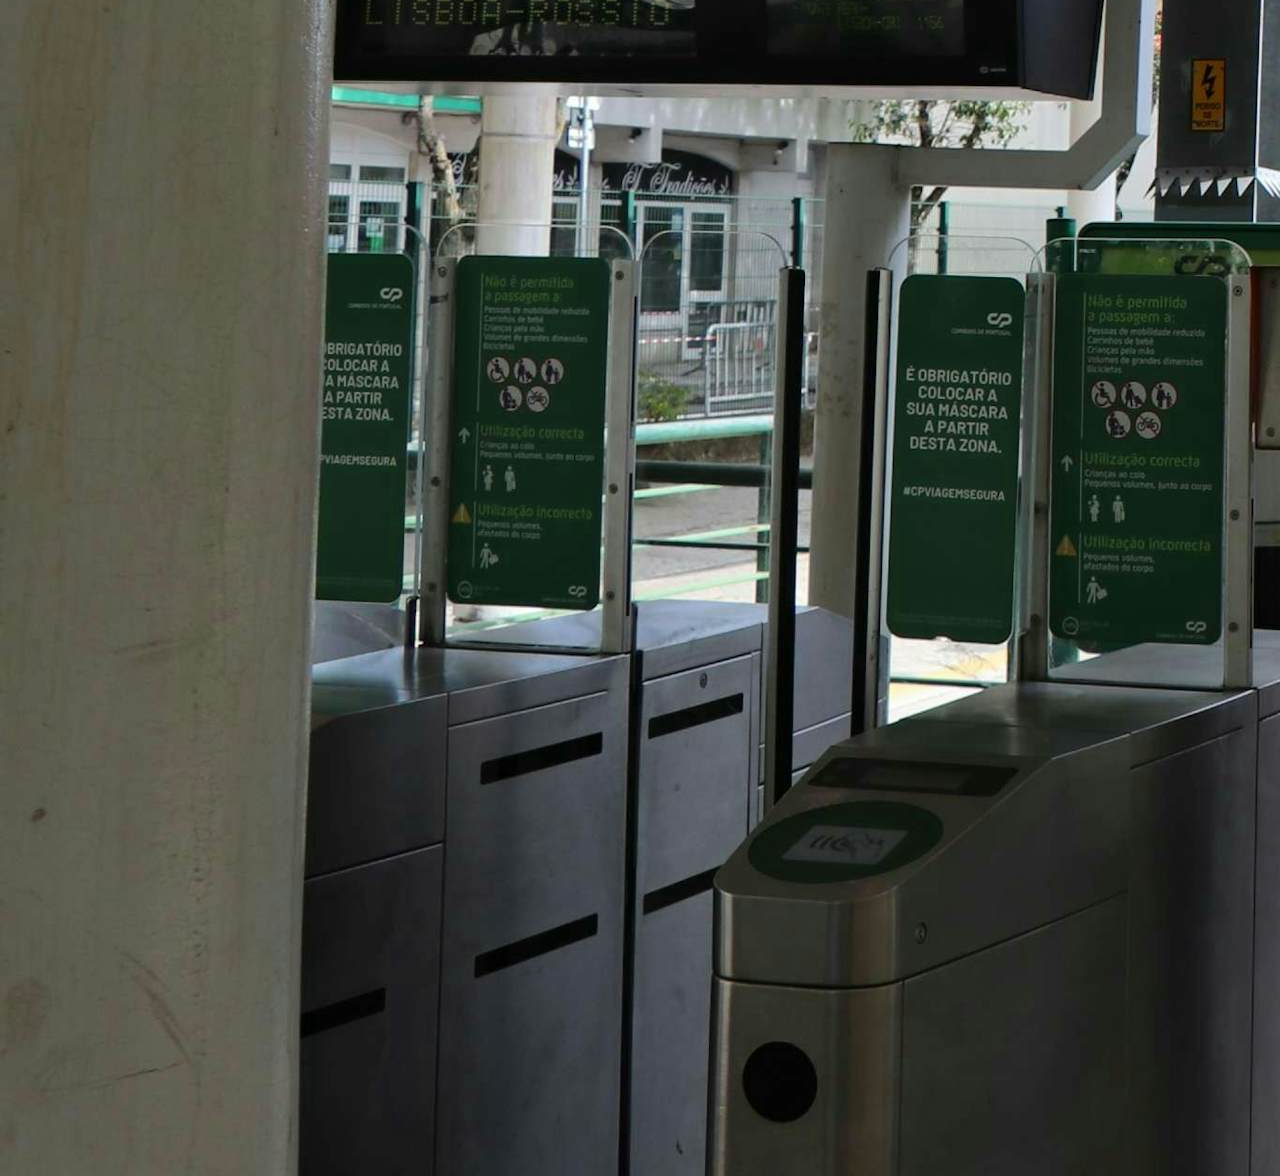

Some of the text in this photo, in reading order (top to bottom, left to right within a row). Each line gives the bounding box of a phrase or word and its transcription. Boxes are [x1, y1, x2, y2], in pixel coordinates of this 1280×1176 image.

[484, 275, 575, 290] Não é permitida
[495, 291, 550, 304] passagem
[1088, 294, 1187, 310] Não é permitida
[987, 313, 1012, 328] CP
[1088, 313, 1095, 321] a
[1099, 312, 1160, 325] passagem
[381, 360, 390, 373] A
[337, 373, 399, 389] MÁSCARA
[906, 365, 1012, 386] É OBRIGATÓRIO
[325, 392, 382, 405] A PARTIR
[918, 386, 998, 402] COLOCAR A
[322, 407, 394, 421] ESTA ZONA.
[906, 402, 1008, 419] SUA MÁSCARA
[481, 425, 585, 440] Utilização correcta
[924, 420, 989, 435] A PARTIR
[910, 436, 1002, 454] DESTA ZONA.
[320, 455, 397, 466] PVIAGEMSEGURA
[1085, 451, 1200, 468] Utilização correcta
[903, 486, 1005, 501] #CPVIAGEMSEGURA
[479, 504, 593, 520] Utilização incorrecta
[1084, 535, 1211, 552] Utilização incorrecta
